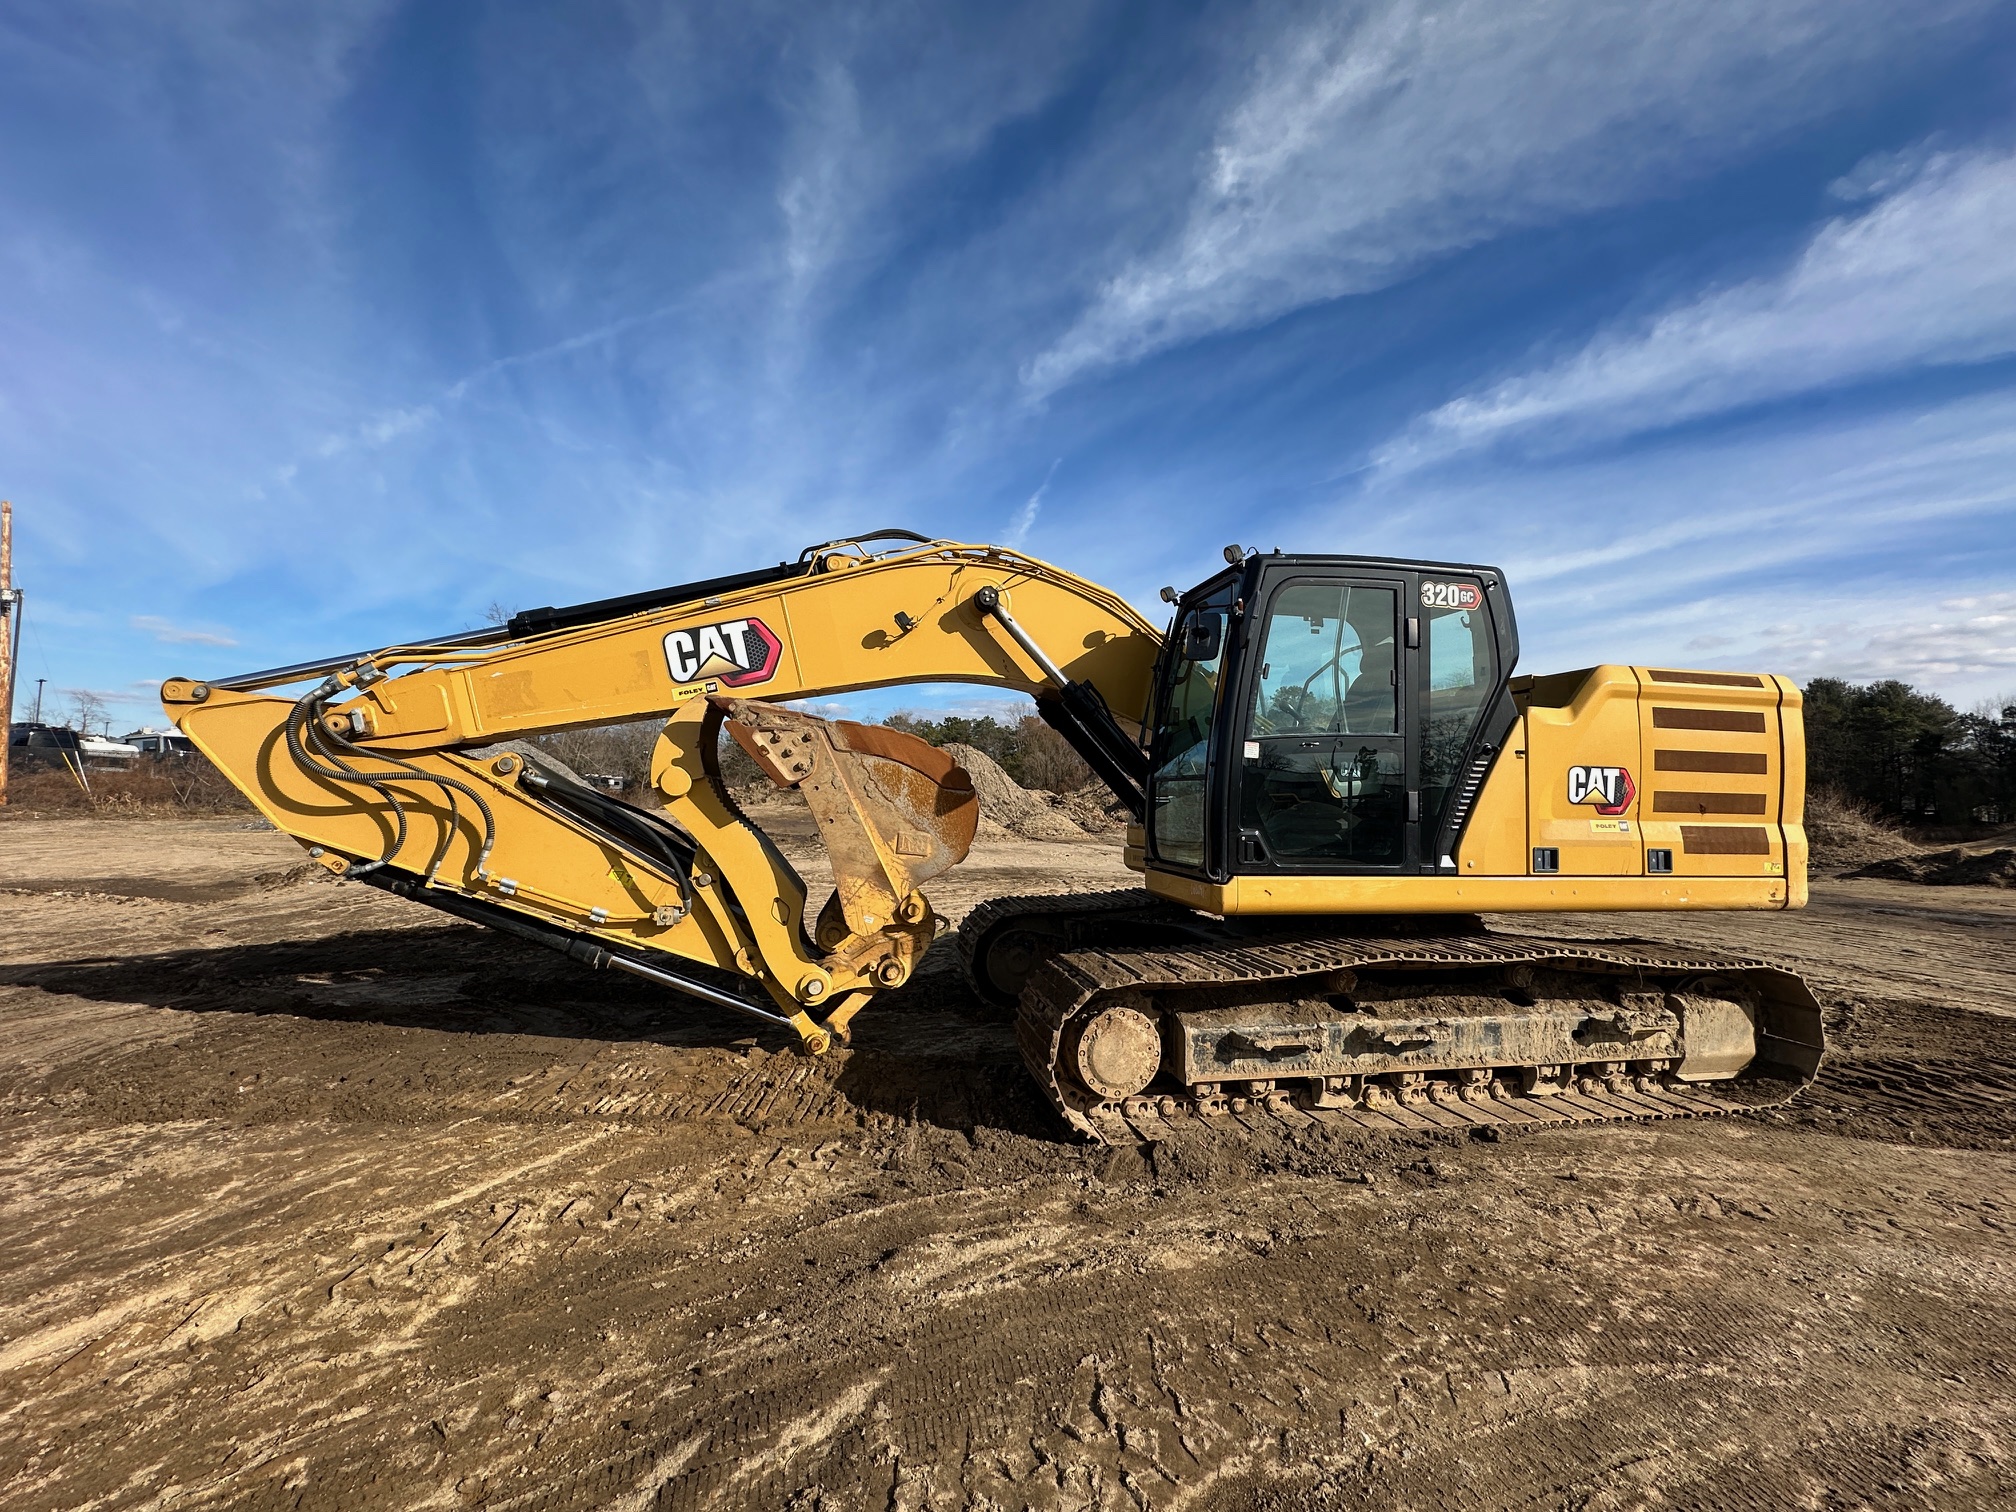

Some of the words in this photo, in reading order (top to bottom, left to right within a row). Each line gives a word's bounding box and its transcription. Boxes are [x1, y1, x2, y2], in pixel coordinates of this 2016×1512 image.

[1423, 583, 1460, 607] 320
[1460, 591, 1474, 603] GC
[664, 620, 750, 682] CAT
[678, 687, 703, 696] FOLEY
[1569, 767, 1620, 804] CAT
